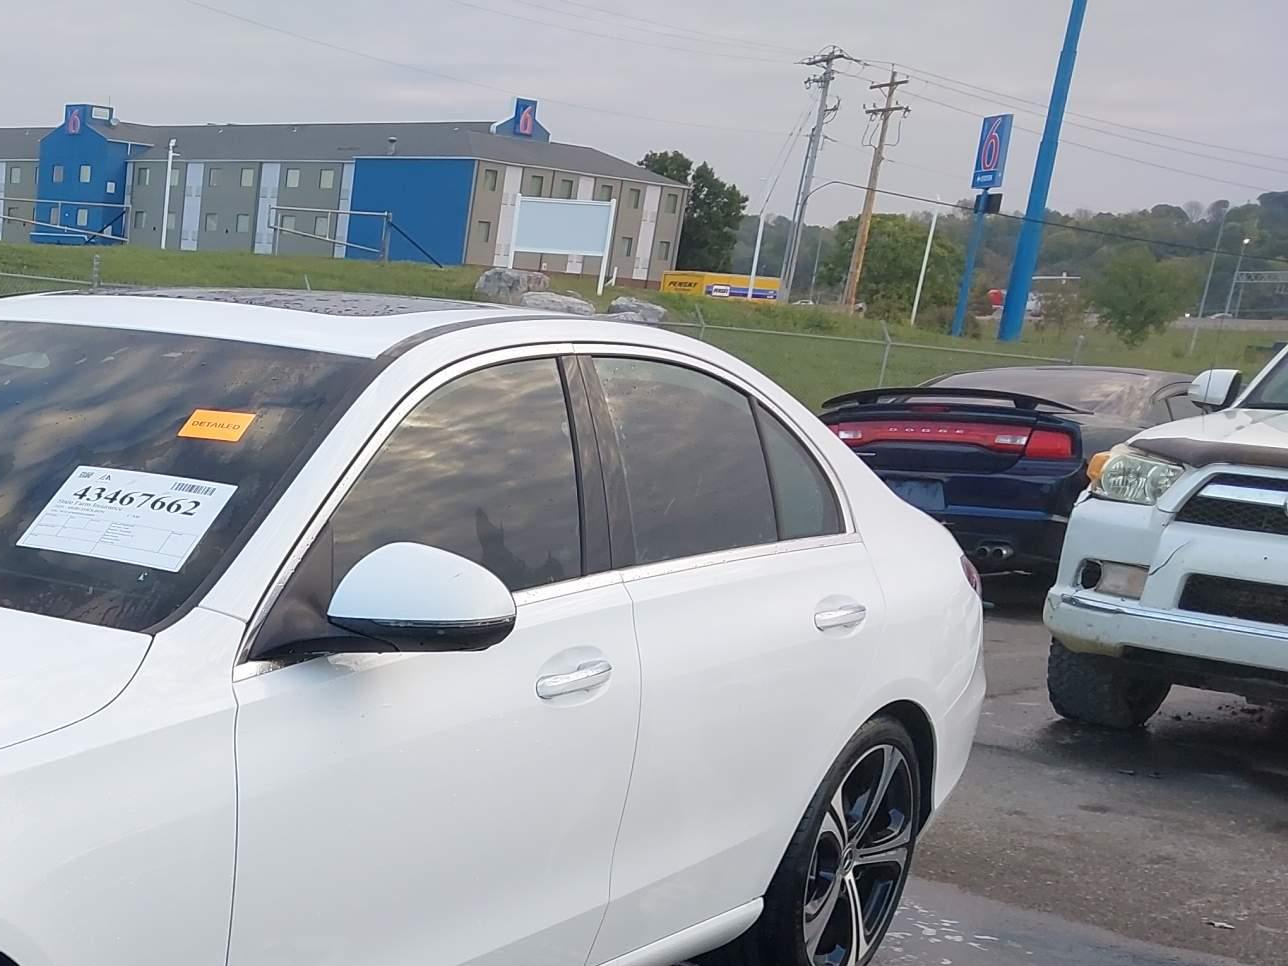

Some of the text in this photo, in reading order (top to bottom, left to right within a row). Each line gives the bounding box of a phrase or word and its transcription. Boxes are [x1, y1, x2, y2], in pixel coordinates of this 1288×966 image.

[981, 117, 1001, 171] 6
[191, 420, 241, 430] DETAILED
[73, 485, 201, 517] 43467662
